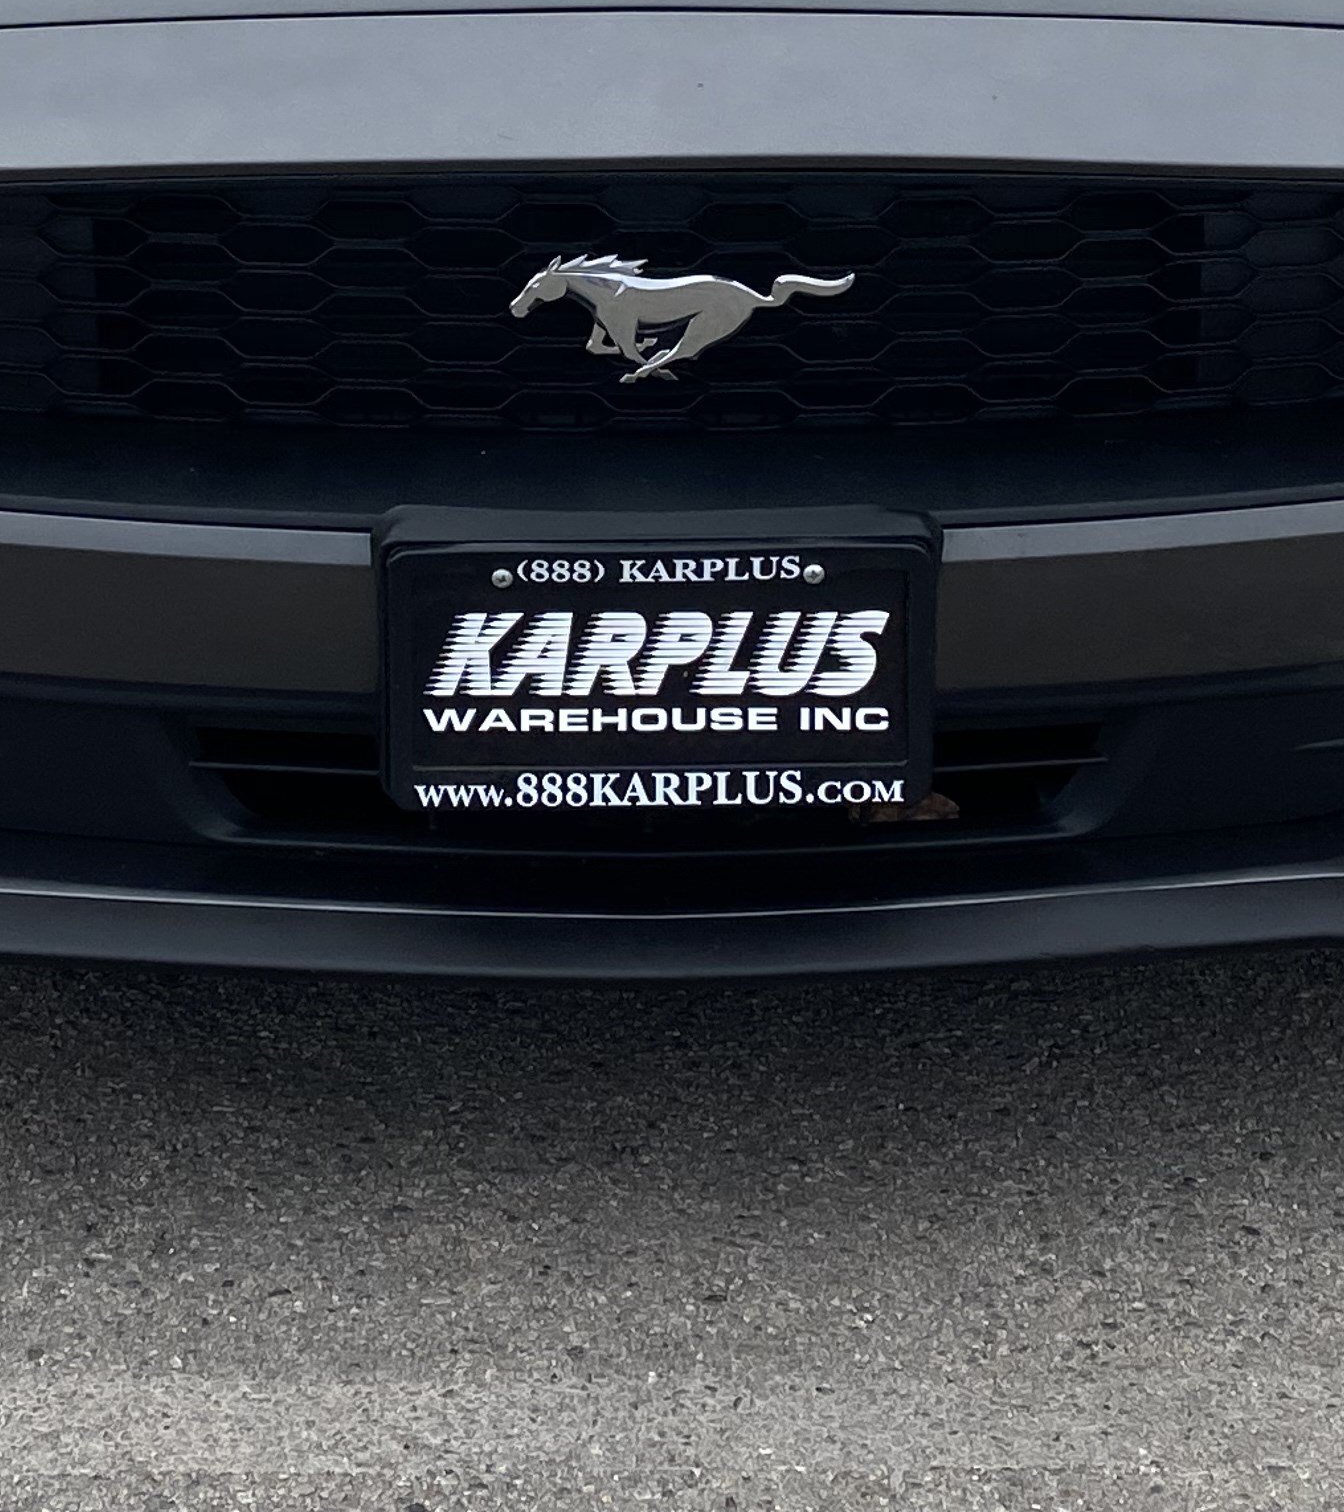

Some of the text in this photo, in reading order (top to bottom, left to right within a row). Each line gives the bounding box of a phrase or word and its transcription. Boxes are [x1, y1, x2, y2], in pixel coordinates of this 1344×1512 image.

[516, 556, 800, 585] (888) KARPLUS
[422, 610, 890, 696] KARPLUS
[423, 706, 890, 732] WAREHOUSE INC
